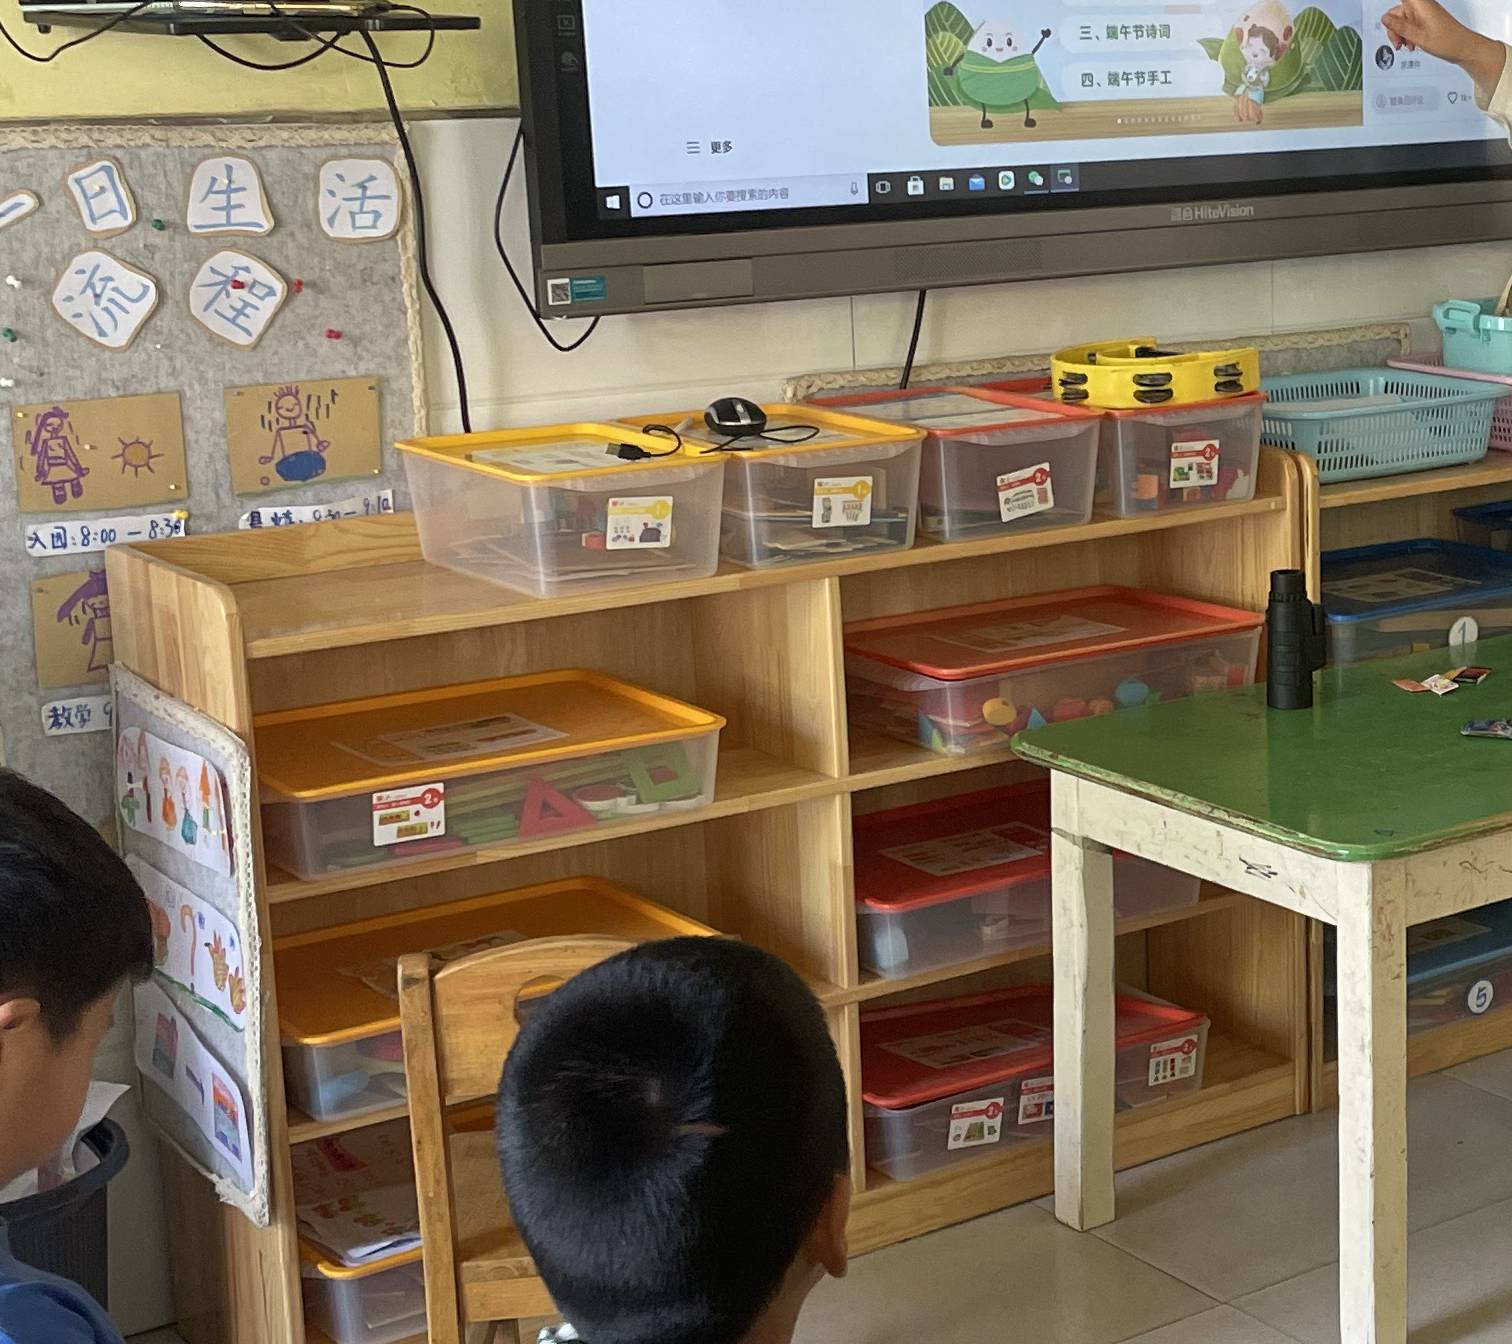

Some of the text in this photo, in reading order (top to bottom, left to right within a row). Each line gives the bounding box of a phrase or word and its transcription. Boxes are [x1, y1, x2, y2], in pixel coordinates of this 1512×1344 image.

[1079, 22, 1171, 42] 三、端午节诗词
[1081, 69, 1172, 89] 四、端午节手工
[710, 140, 733, 155] 更多
[659, 186, 789, 207] 在这里输入你要搜索的内容
[62, 263, 278, 338] 流程
[1475, 986, 1488, 1009] 5
